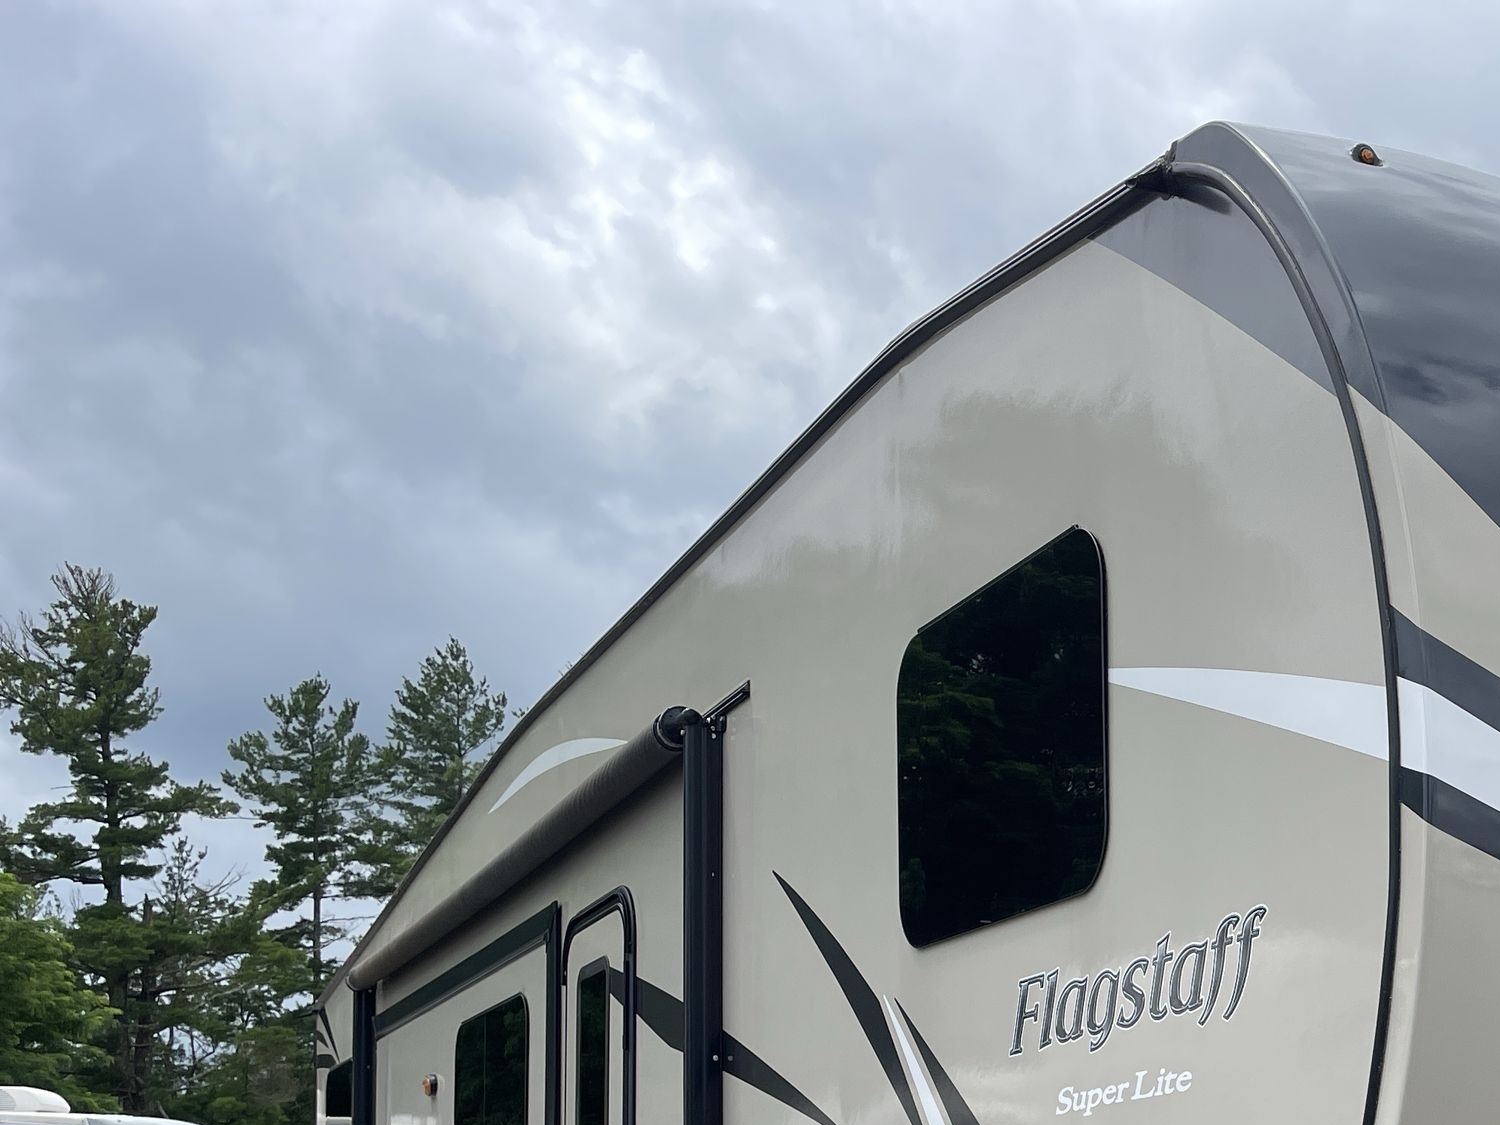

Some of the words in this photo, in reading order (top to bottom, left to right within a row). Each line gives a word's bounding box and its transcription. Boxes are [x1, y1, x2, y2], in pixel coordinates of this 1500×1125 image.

[1008, 903, 1267, 1057] Flagstaff
[1055, 1081, 1130, 1116] Super
[1130, 1068, 1193, 1101] Lite
